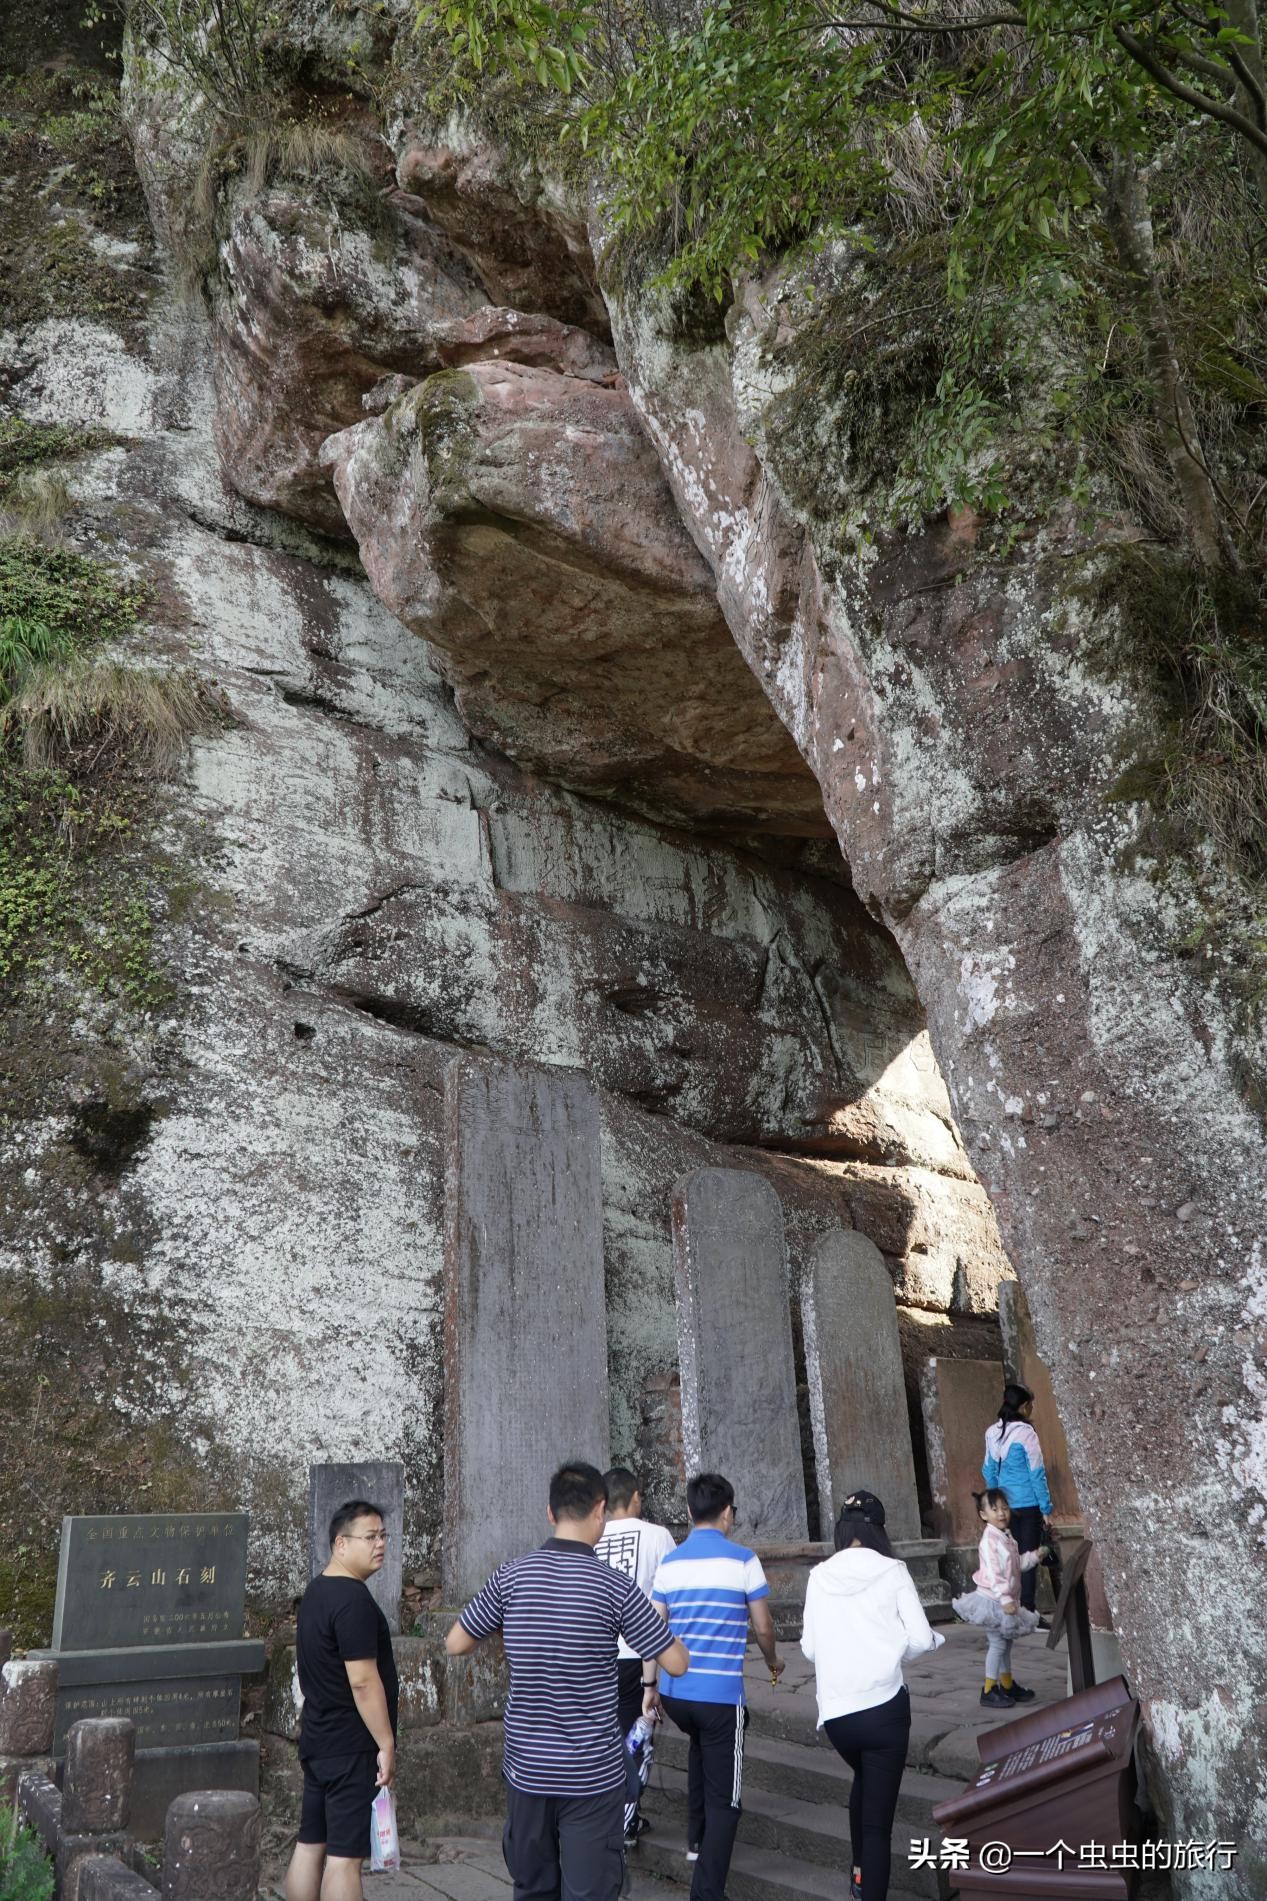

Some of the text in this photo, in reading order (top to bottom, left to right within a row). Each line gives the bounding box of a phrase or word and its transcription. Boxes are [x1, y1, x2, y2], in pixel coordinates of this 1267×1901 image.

[87, 1523, 234, 1541] 全国重点文物保护单位
[100, 1565, 216, 1589] 齐云山石刻
